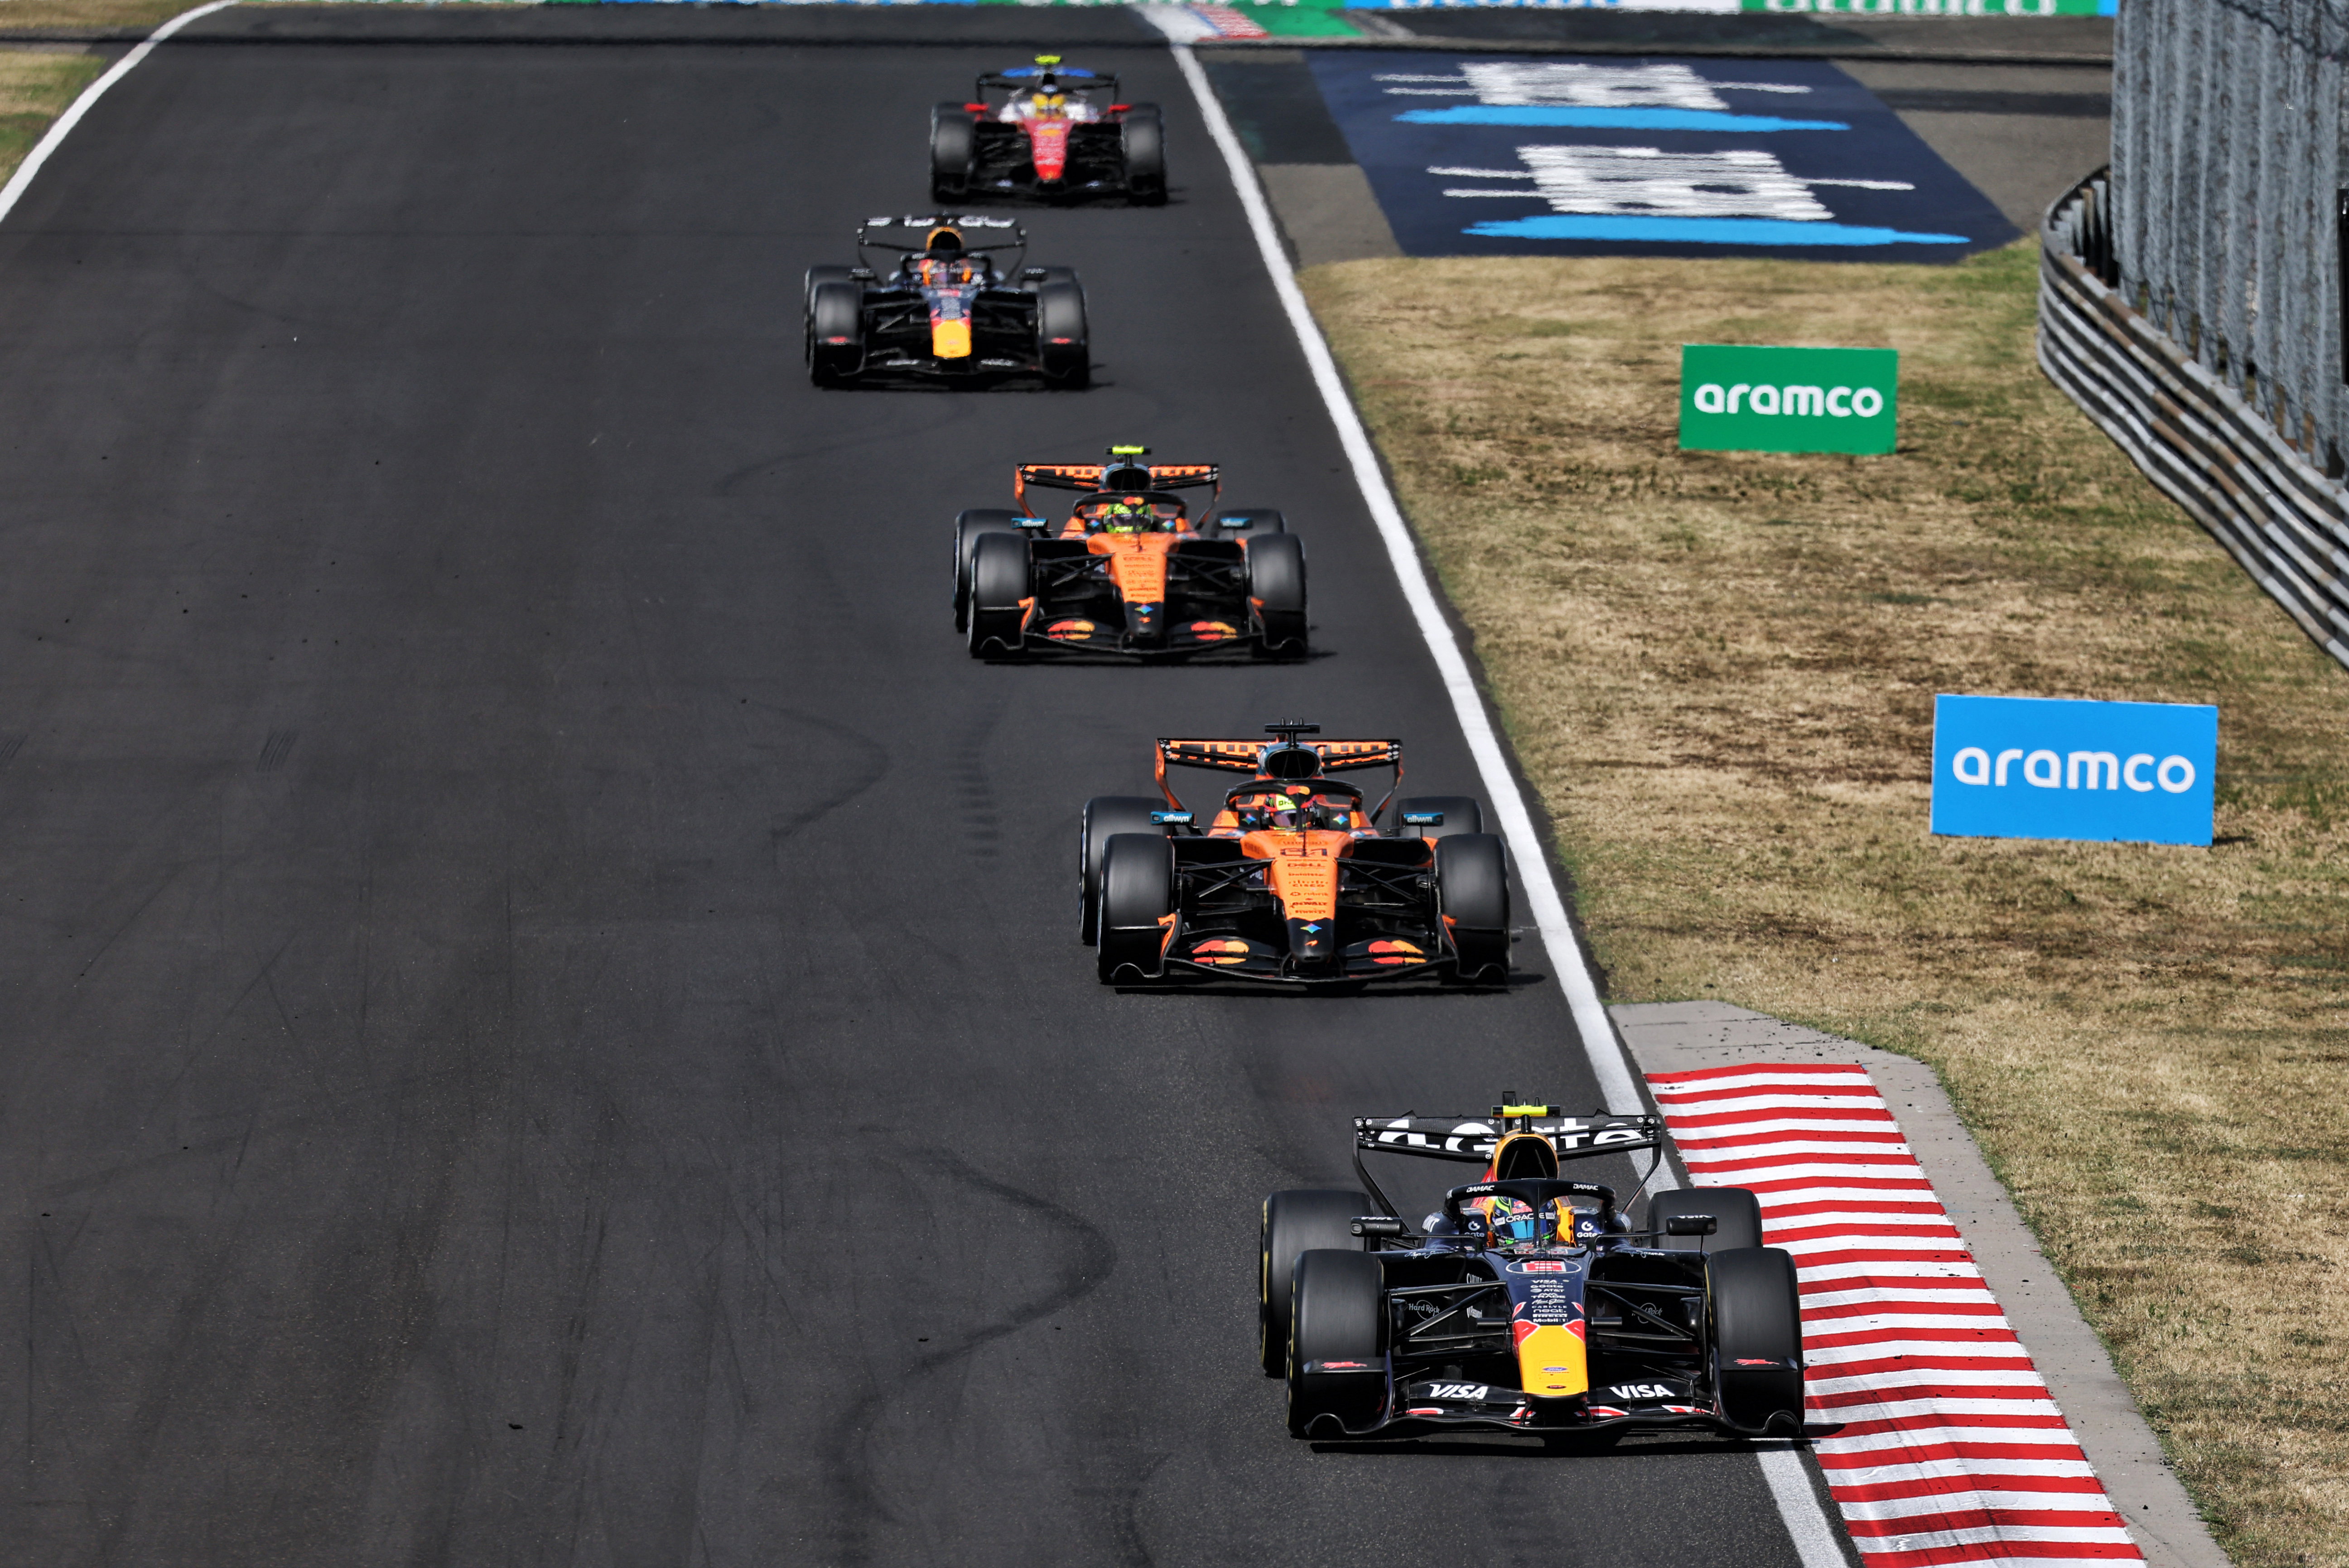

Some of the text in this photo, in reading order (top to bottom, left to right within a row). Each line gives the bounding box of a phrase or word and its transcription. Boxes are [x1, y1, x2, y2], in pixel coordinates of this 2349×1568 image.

[1693, 383, 1883, 417] aramco
[1952, 746, 2195, 793] aramco
[1163, 814, 1189, 823] allwyn
[1407, 815, 1433, 824] allwyn
[1506, 1212, 1545, 1223] ORACE
[1426, 1304, 1440, 1313] Rock
[1429, 1384, 1489, 1399] VISA
[1608, 1384, 1675, 1399] VISA
